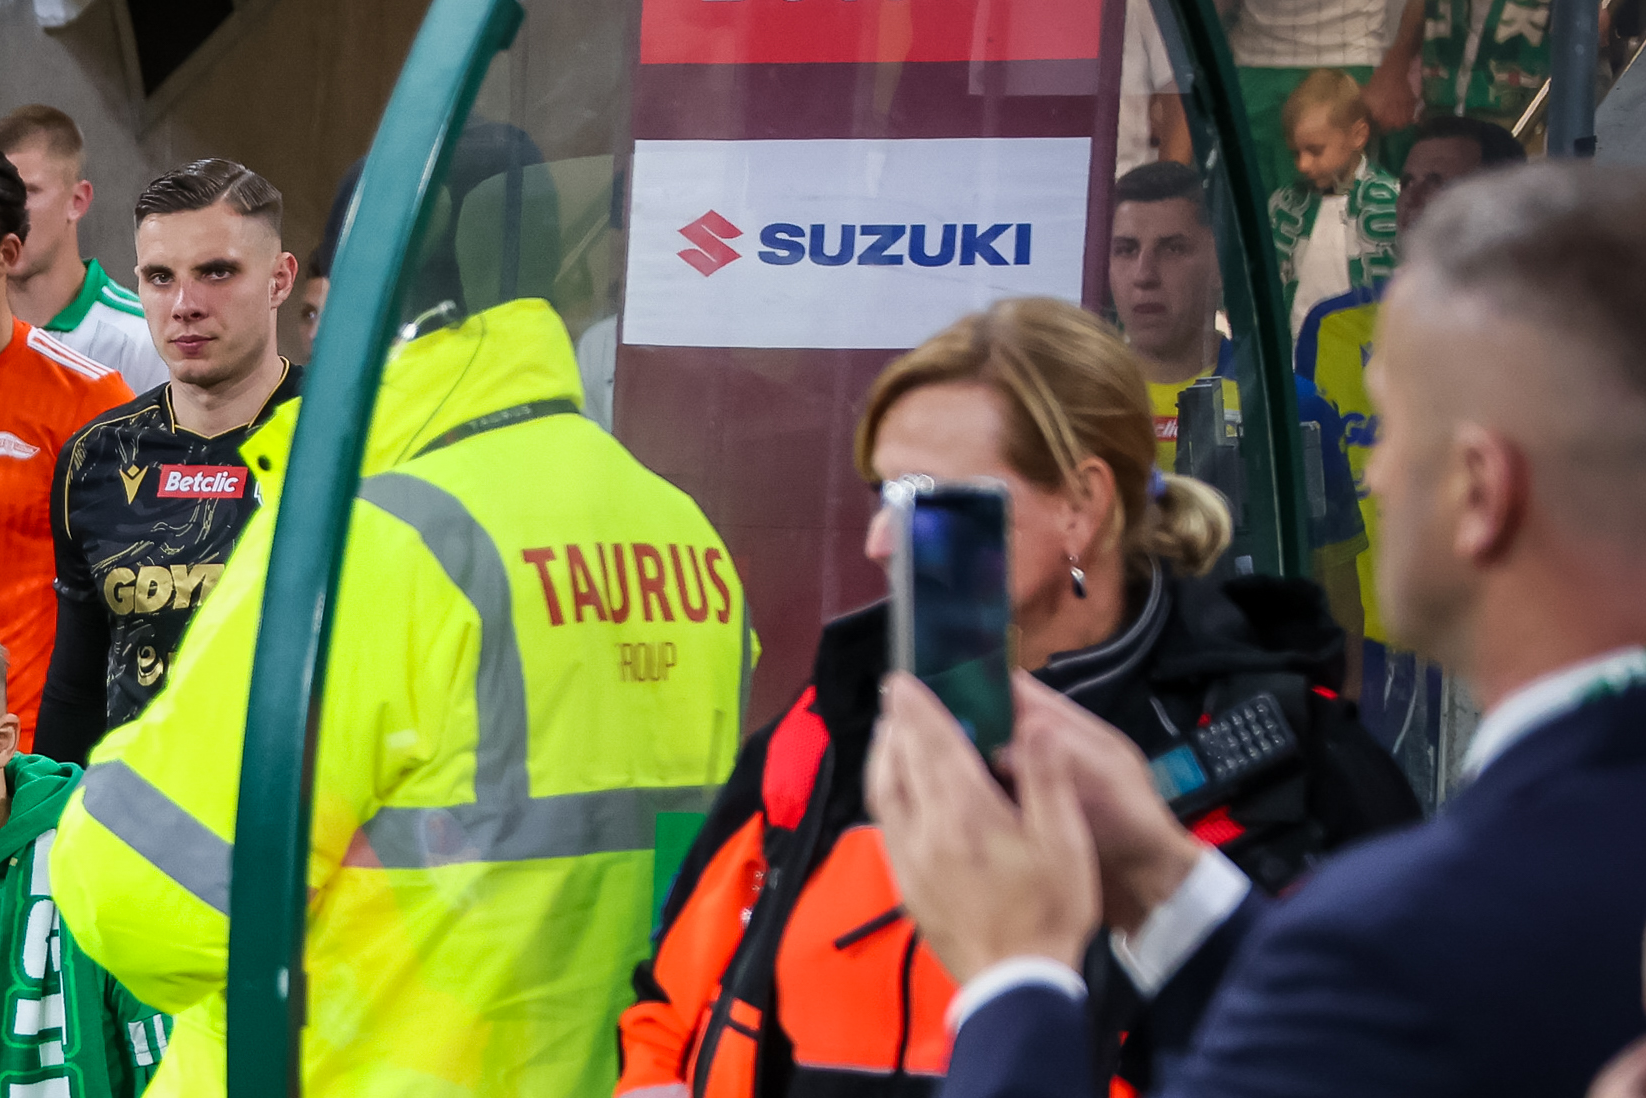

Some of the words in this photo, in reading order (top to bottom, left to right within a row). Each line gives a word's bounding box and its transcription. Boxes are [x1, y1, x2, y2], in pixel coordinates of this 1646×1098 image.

[758, 222, 1032, 267] SUZUKI
[164, 471, 239, 493] Betclic
[520, 542, 732, 627] TAURUS
